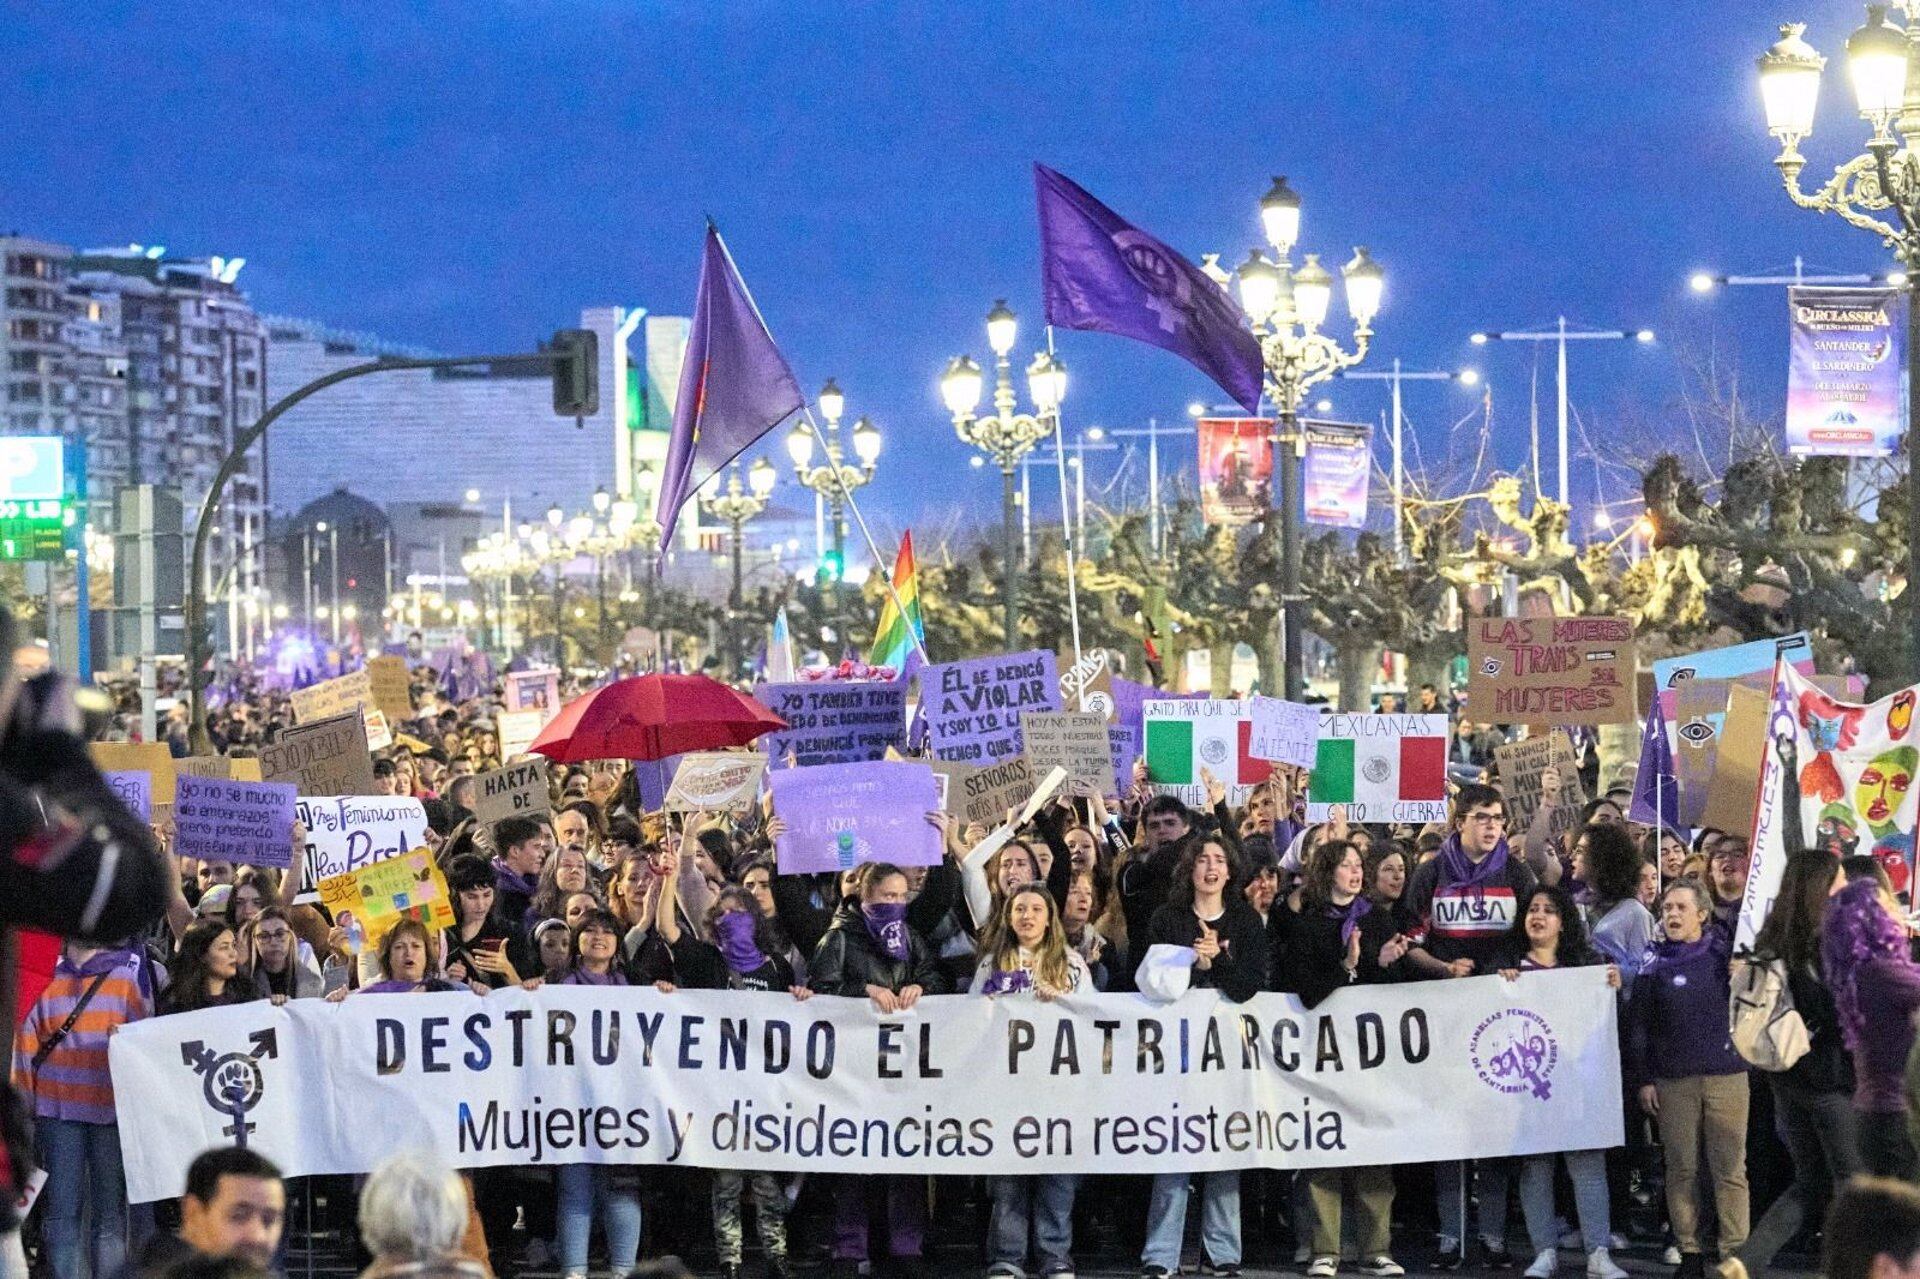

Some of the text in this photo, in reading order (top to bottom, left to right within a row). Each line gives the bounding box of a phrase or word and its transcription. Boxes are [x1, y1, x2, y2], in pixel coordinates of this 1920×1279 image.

[1814, 340, 1871, 352] SANTANDER
[1481, 618, 1632, 643] LAS MUJERES
[1506, 644, 1581, 676] TRANS
[942, 666, 969, 693] ÉL
[996, 656, 1045, 681] DEDICÓ
[782, 692, 804, 710] YO
[808, 687, 863, 709] TAMBIÉN
[942, 680, 1049, 714] A VIOLAR
[1144, 702, 1175, 716] GRITO
[1179, 701, 1200, 716] PARA
[1203, 700, 1223, 716] QUE
[1495, 685, 1615, 713] MUJERES
[822, 714, 837, 727] DE
[937, 722, 947, 738] Y
[948, 716, 973, 736] SOY
[975, 713, 998, 731] YO
[1026, 717, 1048, 728] HOY
[1050, 717, 1067, 727] NO
[1319, 714, 1431, 737] MEXICANAS
[777, 738, 791, 756] Y
[937, 743, 982, 761] TENGO
[986, 738, 1014, 757] QUE
[485, 765, 539, 797] HARTA
[965, 758, 1031, 797] SEÑOROS,
[204, 786, 222, 799] no
[246, 789, 287, 806] mucho
[512, 792, 531, 809] DE
[313, 805, 337, 832] hay
[334, 797, 421, 832] Feminismo
[1327, 803, 1367, 821] GITO
[1392, 802, 1447, 821] GUERRA
[1436, 900, 1507, 922] NASA
[376, 1007, 1430, 1080] DESTRUYENDO EL PATRIARCADO
[1470, 1008, 1558, 1079] ASAMBLEAS FEMINISTAS ABIERTAS
[1472, 1057, 1530, 1094] DE CANTABRIA
[458, 1096, 1347, 1162] Mujeres y disidencias en resistencia
